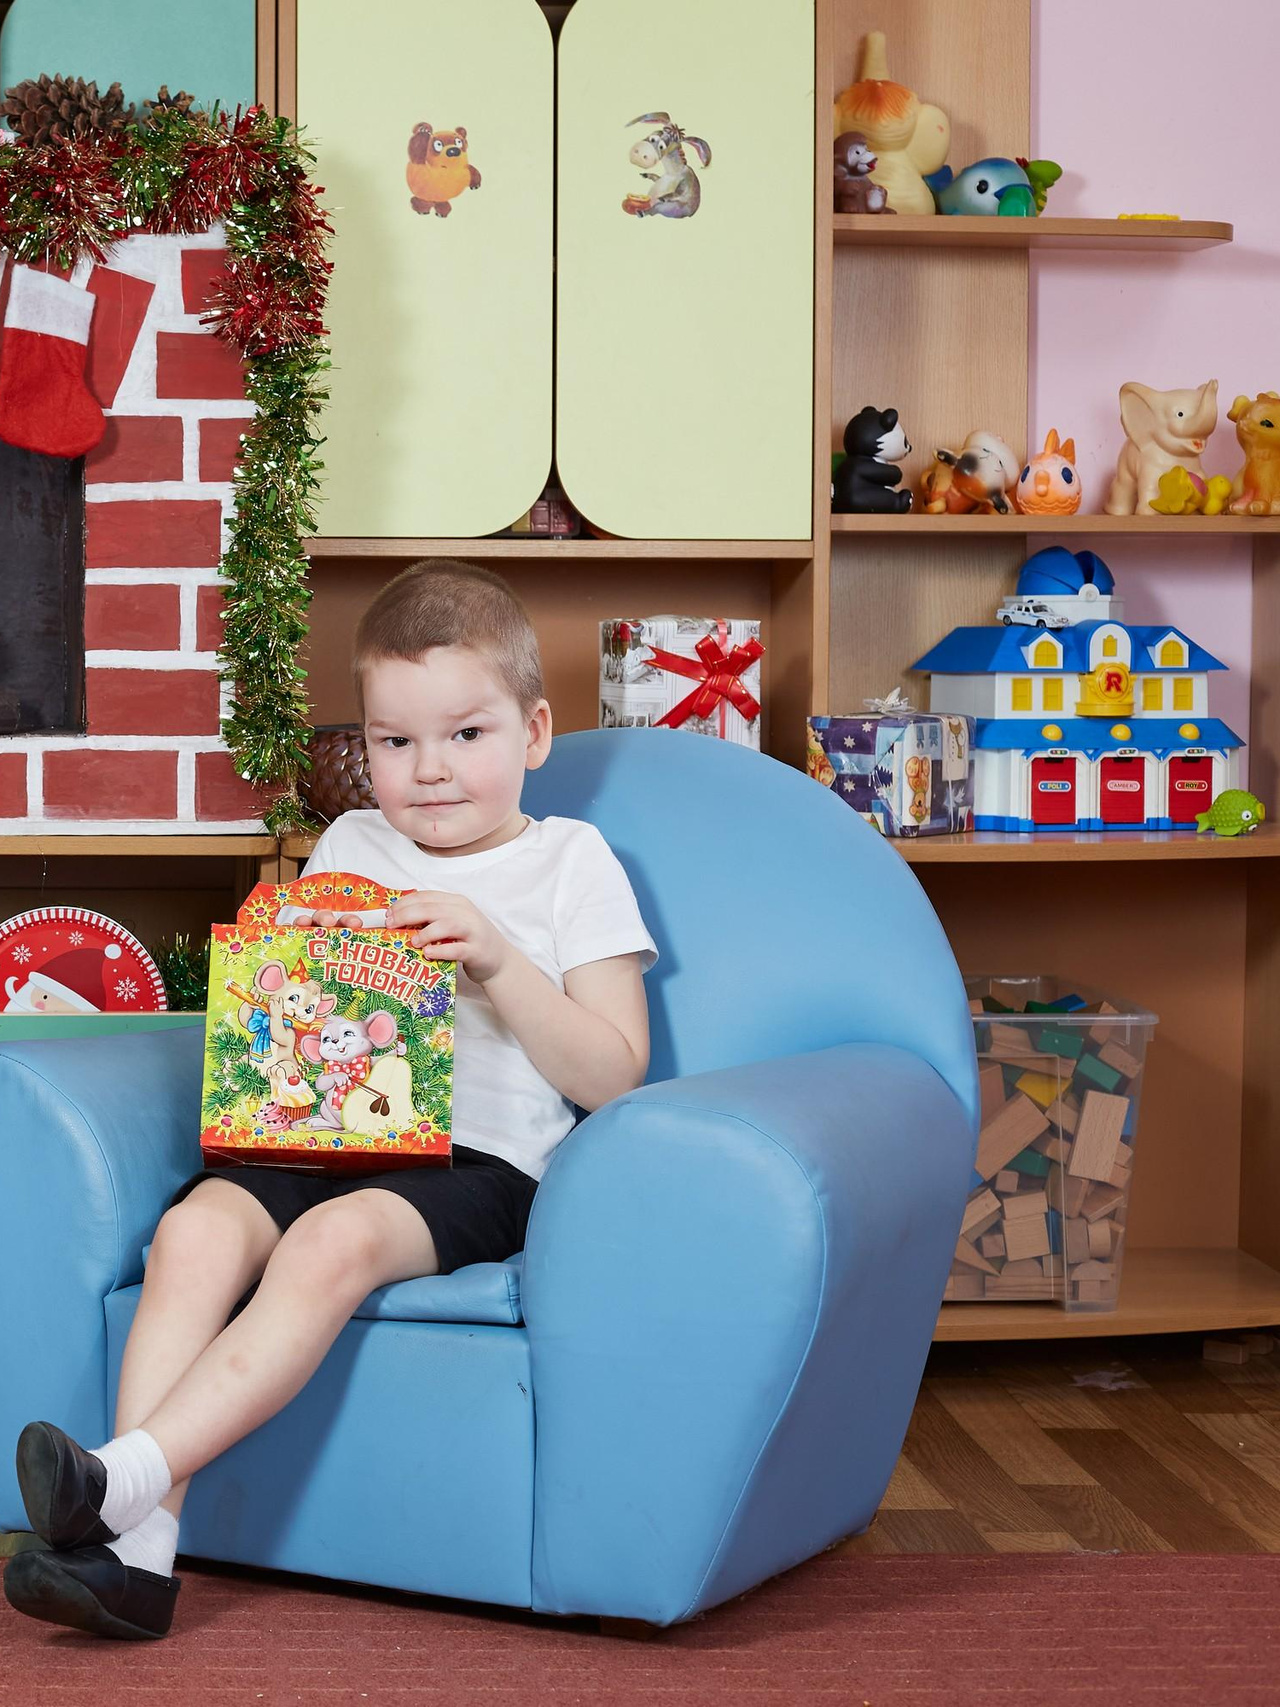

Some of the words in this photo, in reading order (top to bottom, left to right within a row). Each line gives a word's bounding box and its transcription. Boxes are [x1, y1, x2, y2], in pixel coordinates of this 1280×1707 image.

[1105, 671, 1123, 692] R
[307, 938, 329, 960] С
[337, 940, 445, 990] НОВЫМ
[323, 961, 419, 1003] ГОДОМ!
